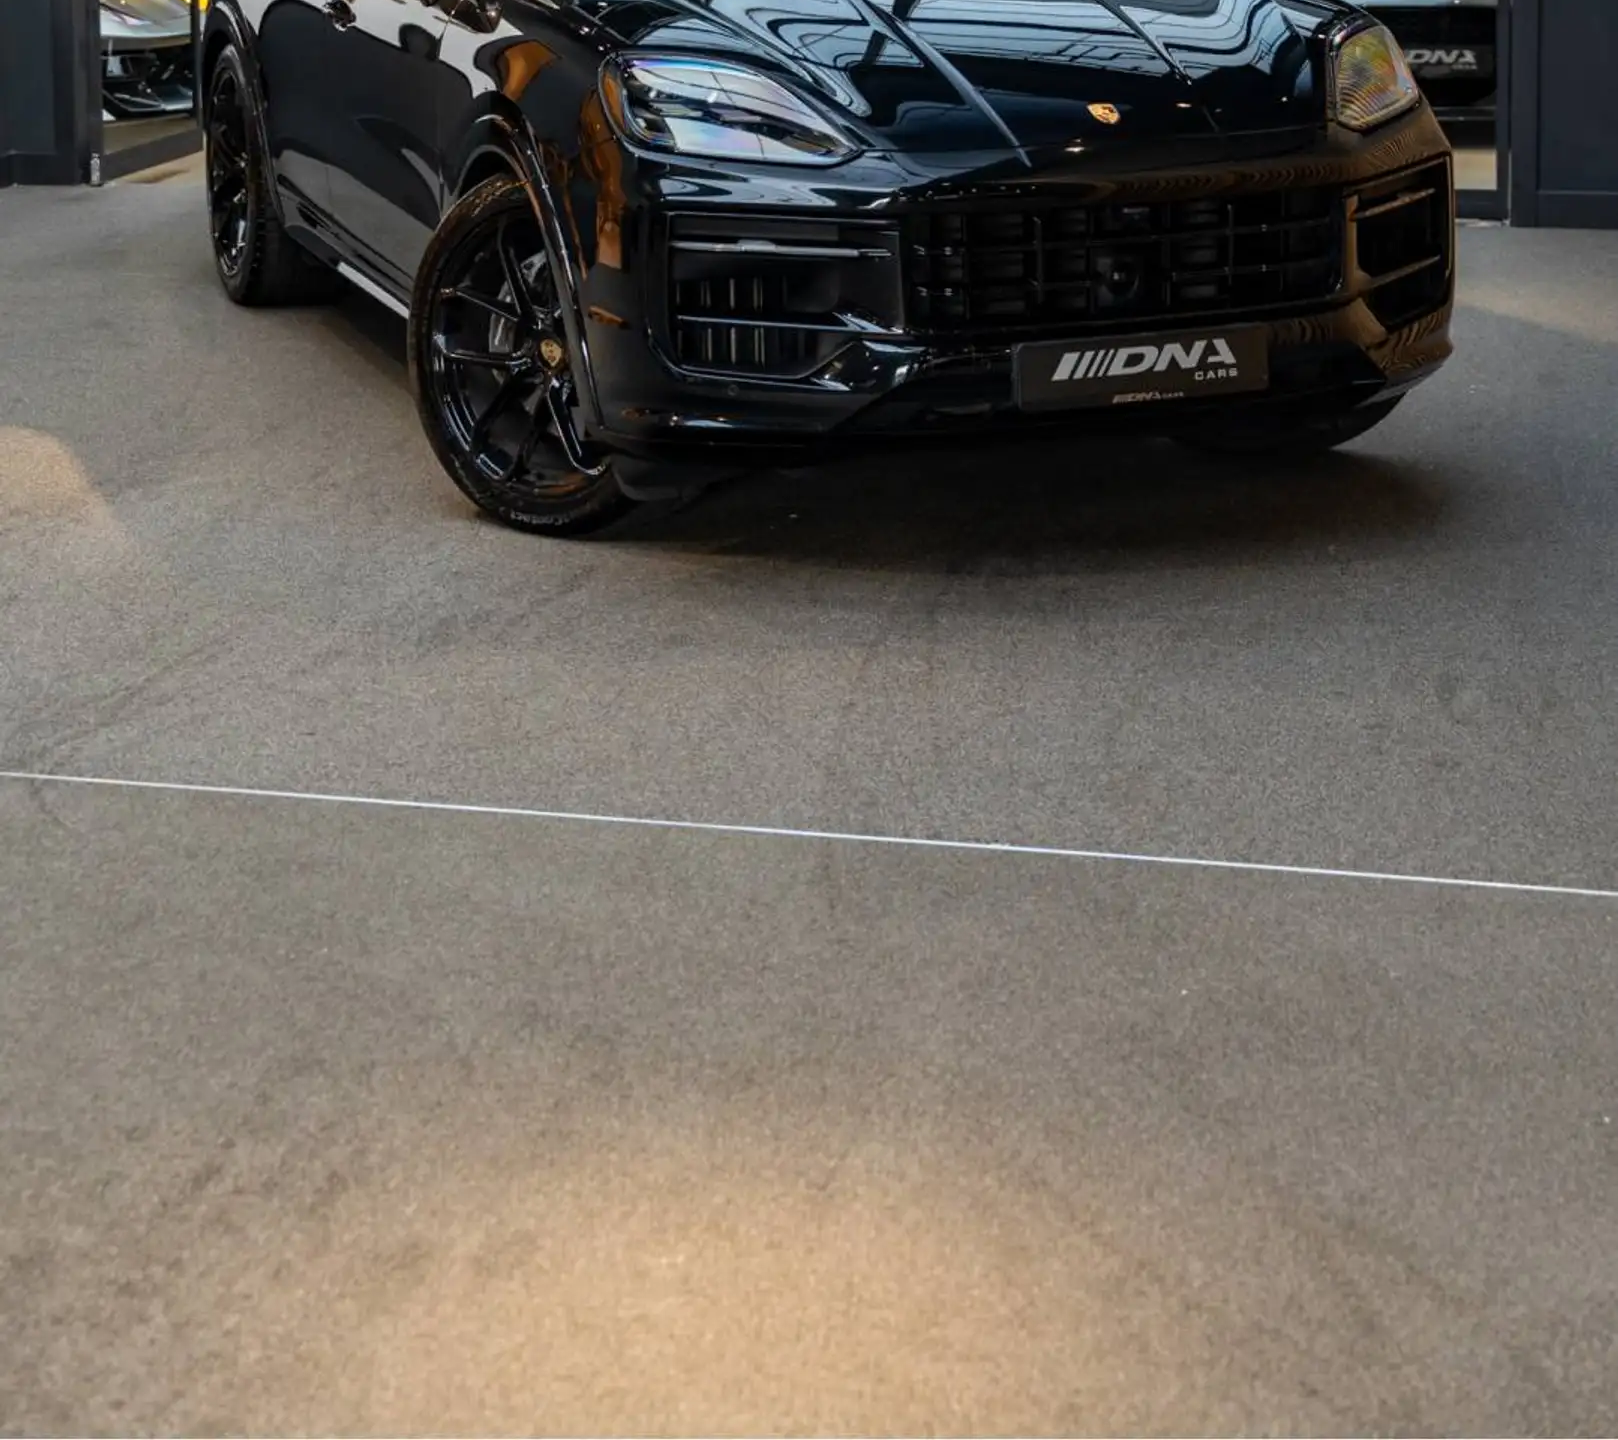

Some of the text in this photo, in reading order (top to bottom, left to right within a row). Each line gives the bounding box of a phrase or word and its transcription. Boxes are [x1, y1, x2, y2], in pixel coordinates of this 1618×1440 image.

[1405, 49, 1477, 64] DNA
[1106, 338, 1237, 376] DNA
[1193, 367, 1239, 381] CARS
